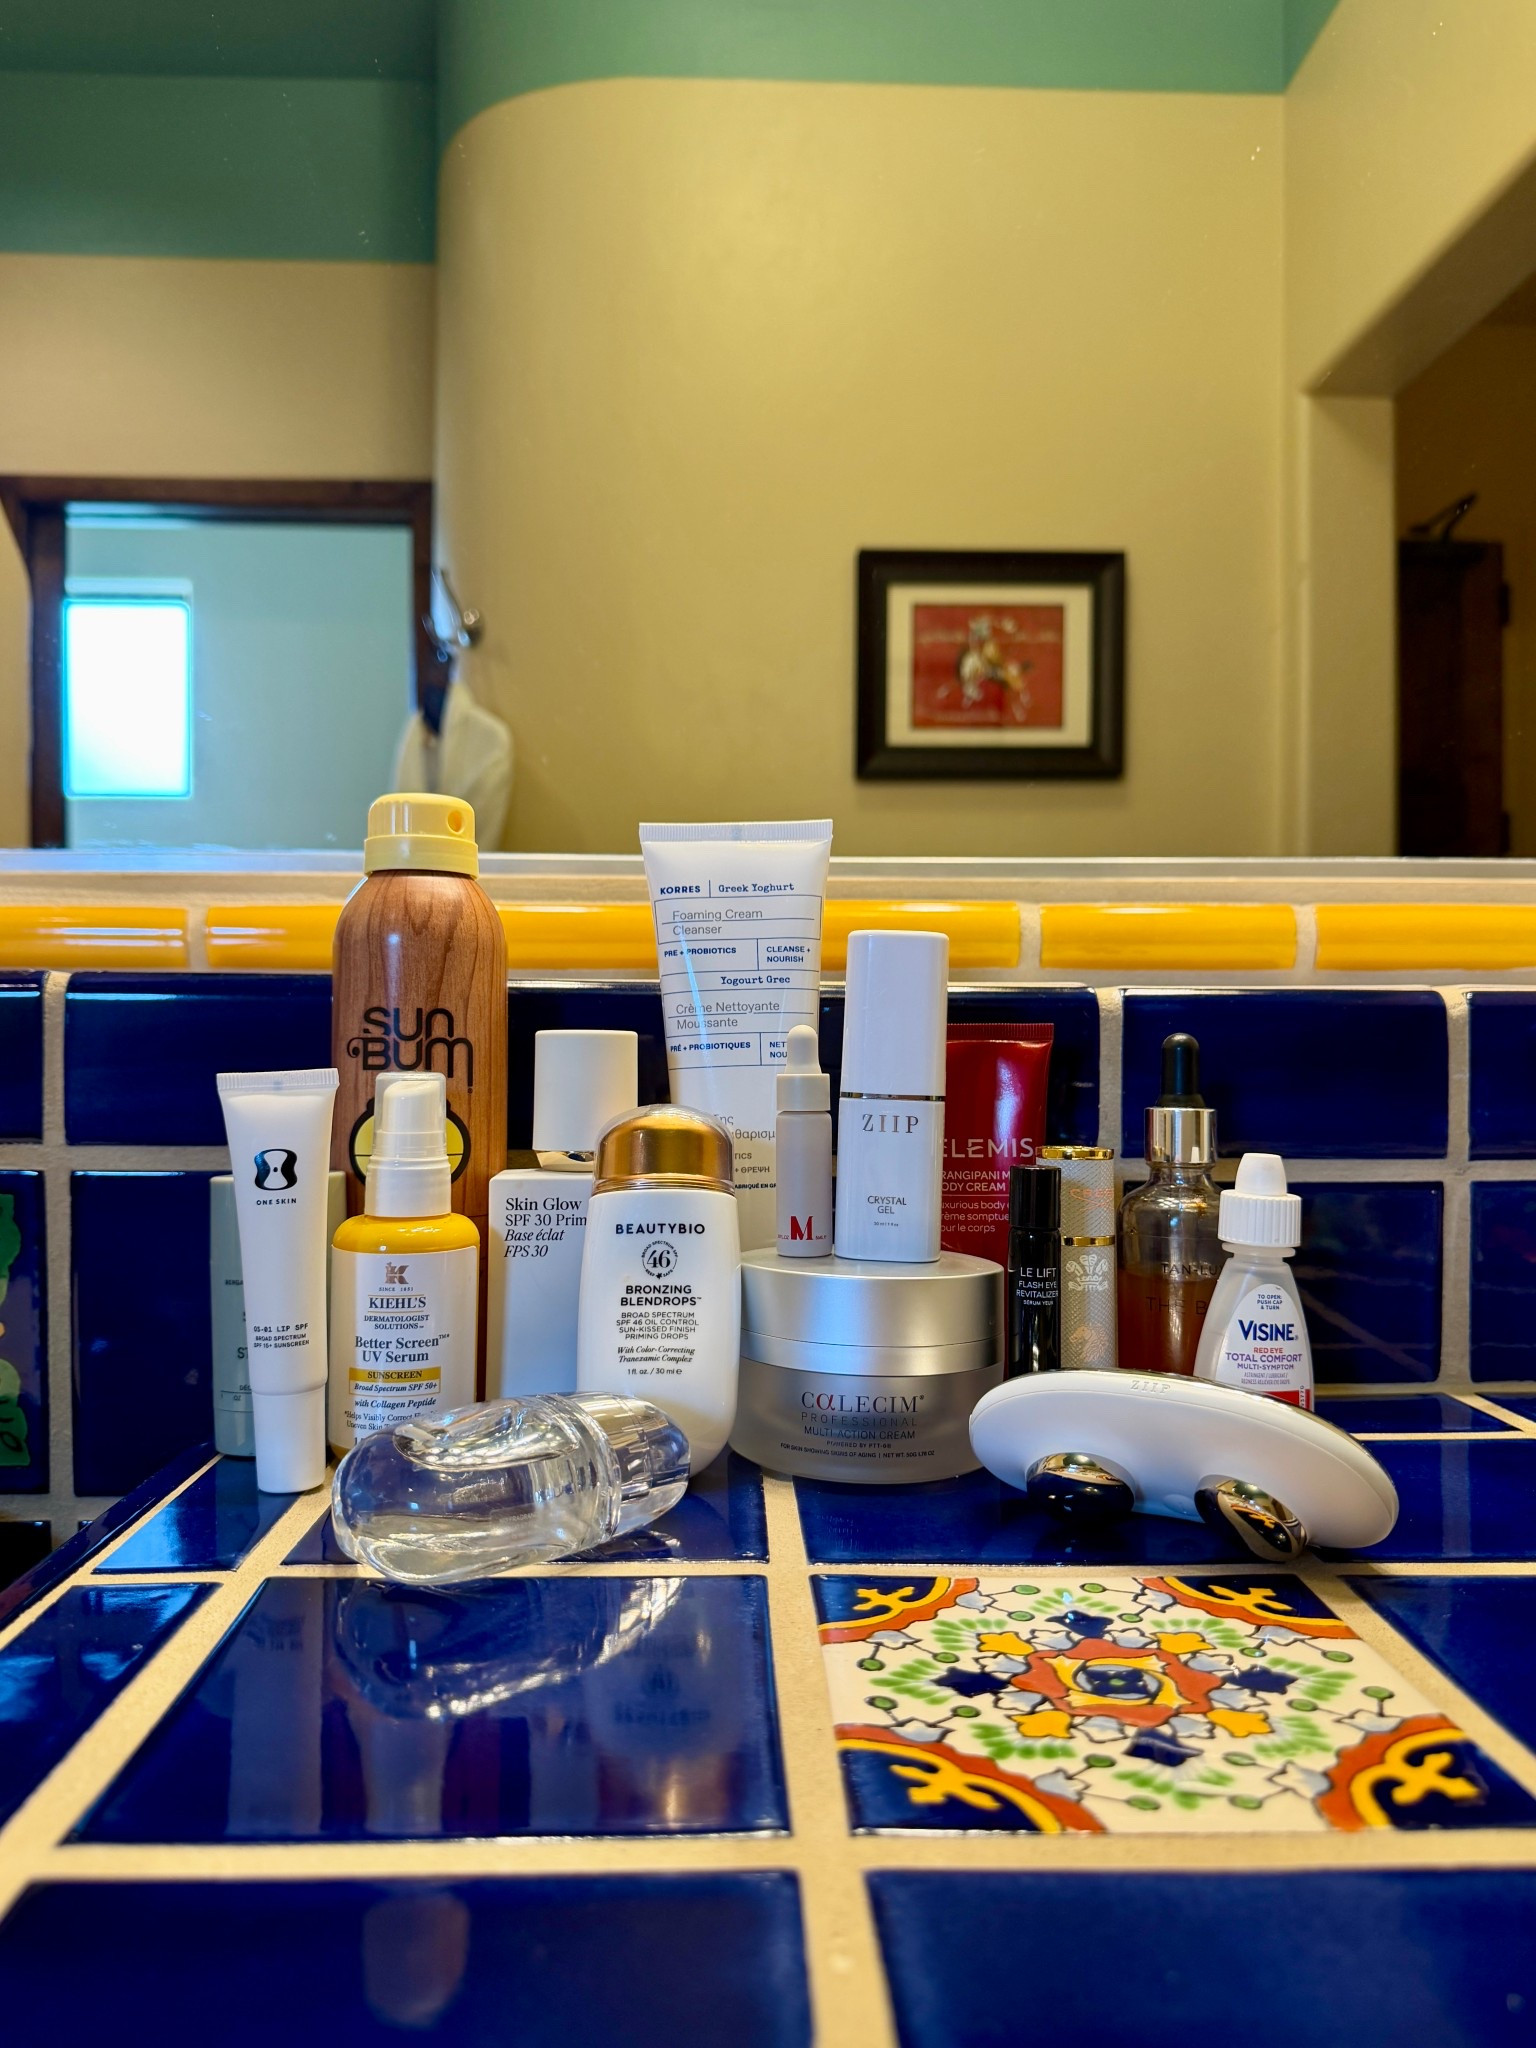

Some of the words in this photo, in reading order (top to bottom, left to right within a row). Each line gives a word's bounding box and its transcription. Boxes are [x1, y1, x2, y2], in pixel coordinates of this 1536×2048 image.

[660, 885, 701, 895] KORRES
[718, 884, 749, 893] Greek
[751, 883, 795, 894] Yoghurt
[672, 910, 722, 922] Foaming
[725, 909, 763, 919] Cream
[672, 925, 722, 936] Cleanser
[664, 949, 678, 957] PRE
[686, 947, 737, 955] PROBIOTICS
[720, 975, 764, 986] Yogourt
[766, 976, 791, 984] Grec
[676, 1003, 712, 1015] Crème
[716, 1001, 780, 1014] Nettoyante
[676, 1017, 738, 1030] Moussante
[689, 1041, 751, 1050] PROBIOTIQUES
[862, 1113, 919, 1133] ZIIP
[734, 1128, 776, 1141] θαρισμ
[942, 1170, 1000, 1180] RANGIPANI
[942, 1182, 964, 1191] ODY
[966, 1182, 1006, 1191] CREAM
[505, 1197, 538, 1211] Skin
[543, 1197, 582, 1211] Glow
[867, 1195, 907, 1206] CRYSTAL
[942, 1200, 979, 1209] uxurious
[980, 1200, 1005, 1211] body
[877, 1206, 895, 1214] GEL
[505, 1214, 531, 1226] SPF
[534, 1214, 552, 1226] 30
[556, 1214, 587, 1226] Prim
[941, 1212, 965, 1220] rème
[967, 1213, 1009, 1222] somptue
[615, 1223, 705, 1234] BEAUTYBIO
[790, 1215, 813, 1240] M
[958, 1223, 966, 1232] le
[967, 1225, 996, 1234] corps
[504, 1229, 534, 1241] Base
[535, 1228, 565, 1241] éclat
[504, 1245, 530, 1258] FPS
[531, 1244, 549, 1258] 30
[646, 1249, 671, 1268] 46
[1020, 1266, 1033, 1277] LE
[1036, 1267, 1057, 1278] LIFT
[626, 1285, 692, 1294] BRONZING
[1018, 1280, 1044, 1289] FLASH
[1045, 1280, 1057, 1289] EYE
[1016, 1289, 1059, 1299] REVITALIZER
[368, 1296, 426, 1309] KIEHL'S
[1146, 1296, 1184, 1314] THE
[364, 1314, 430, 1322] DERMATOLOGIST
[276, 1325, 291, 1333] LIP
[295, 1323, 309, 1331] SPF
[273, 1333, 307, 1341] SPECTRUM
[355, 1335, 392, 1349] Better
[273, 1340, 310, 1348] SUNSCREEN
[617, 1346, 634, 1354] With
[636, 1345, 695, 1356] Color-Correcting
[362, 1350, 382, 1362] UV
[385, 1351, 429, 1363] Serum
[661, 1354, 693, 1364] Complex
[1225, 1352, 1258, 1363] TOTAL
[1260, 1353, 1302, 1363] COMFORT
[367, 1370, 422, 1379] SUNSCREEN
[354, 1383, 374, 1391] Broad
[374, 1383, 407, 1393] Spectrum
[408, 1383, 423, 1391] SPF
[424, 1382, 438, 1390] 50+
[1130, 1380, 1171, 1394] ZIIP
[354, 1399, 369, 1408] with
[370, 1400, 405, 1410] Collagen
[407, 1398, 436, 1409] Peptide
[363, 1413, 385, 1422] Visibly
[801, 1411, 917, 1427] PROFESSIONAL
[346, 1420, 367, 1429] Uneven
[879, 1430, 915, 1440] CREAM
[791, 1444, 803, 1452] SKIN
[803, 1446, 830, 1455] SHOWING
